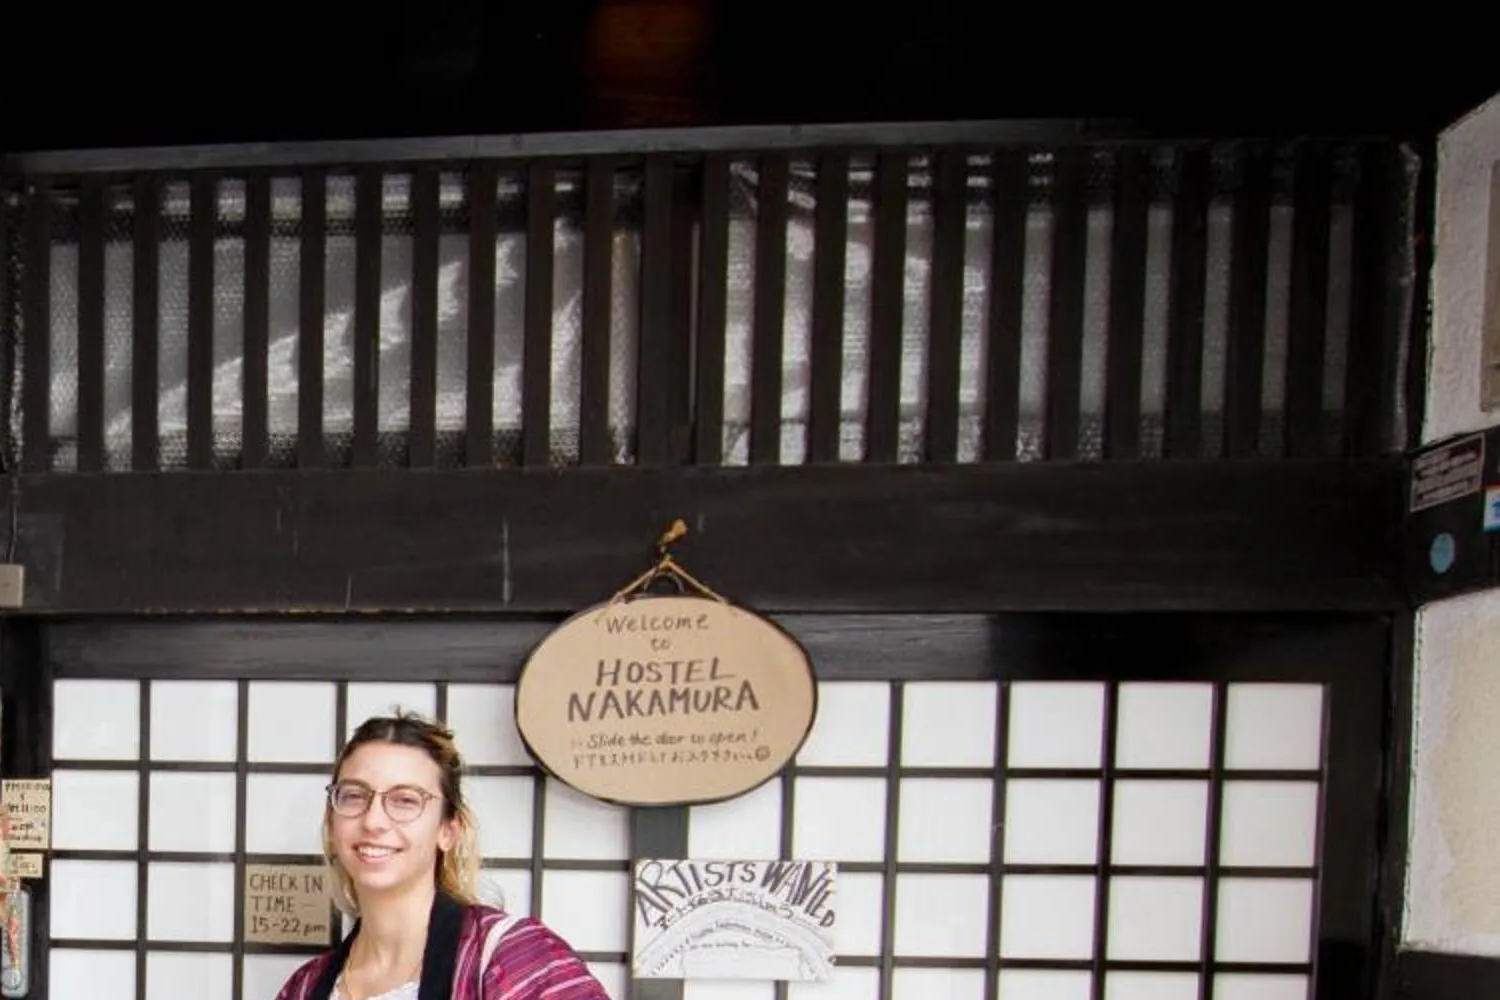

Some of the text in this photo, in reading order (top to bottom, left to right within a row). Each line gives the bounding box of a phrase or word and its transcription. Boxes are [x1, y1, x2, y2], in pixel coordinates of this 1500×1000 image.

[605, 613, 710, 634] Welcome
[650, 636, 671, 652] to
[595, 656, 737, 687] HOSTEL
[567, 679, 760, 723] NAKAMURA
[630, 732, 650, 745] the
[249, 873, 323, 894] CHECK IN
[635, 859, 757, 928] ARTISTS
[759, 860, 837, 928] WANTED
[249, 895, 296, 913] TIME
